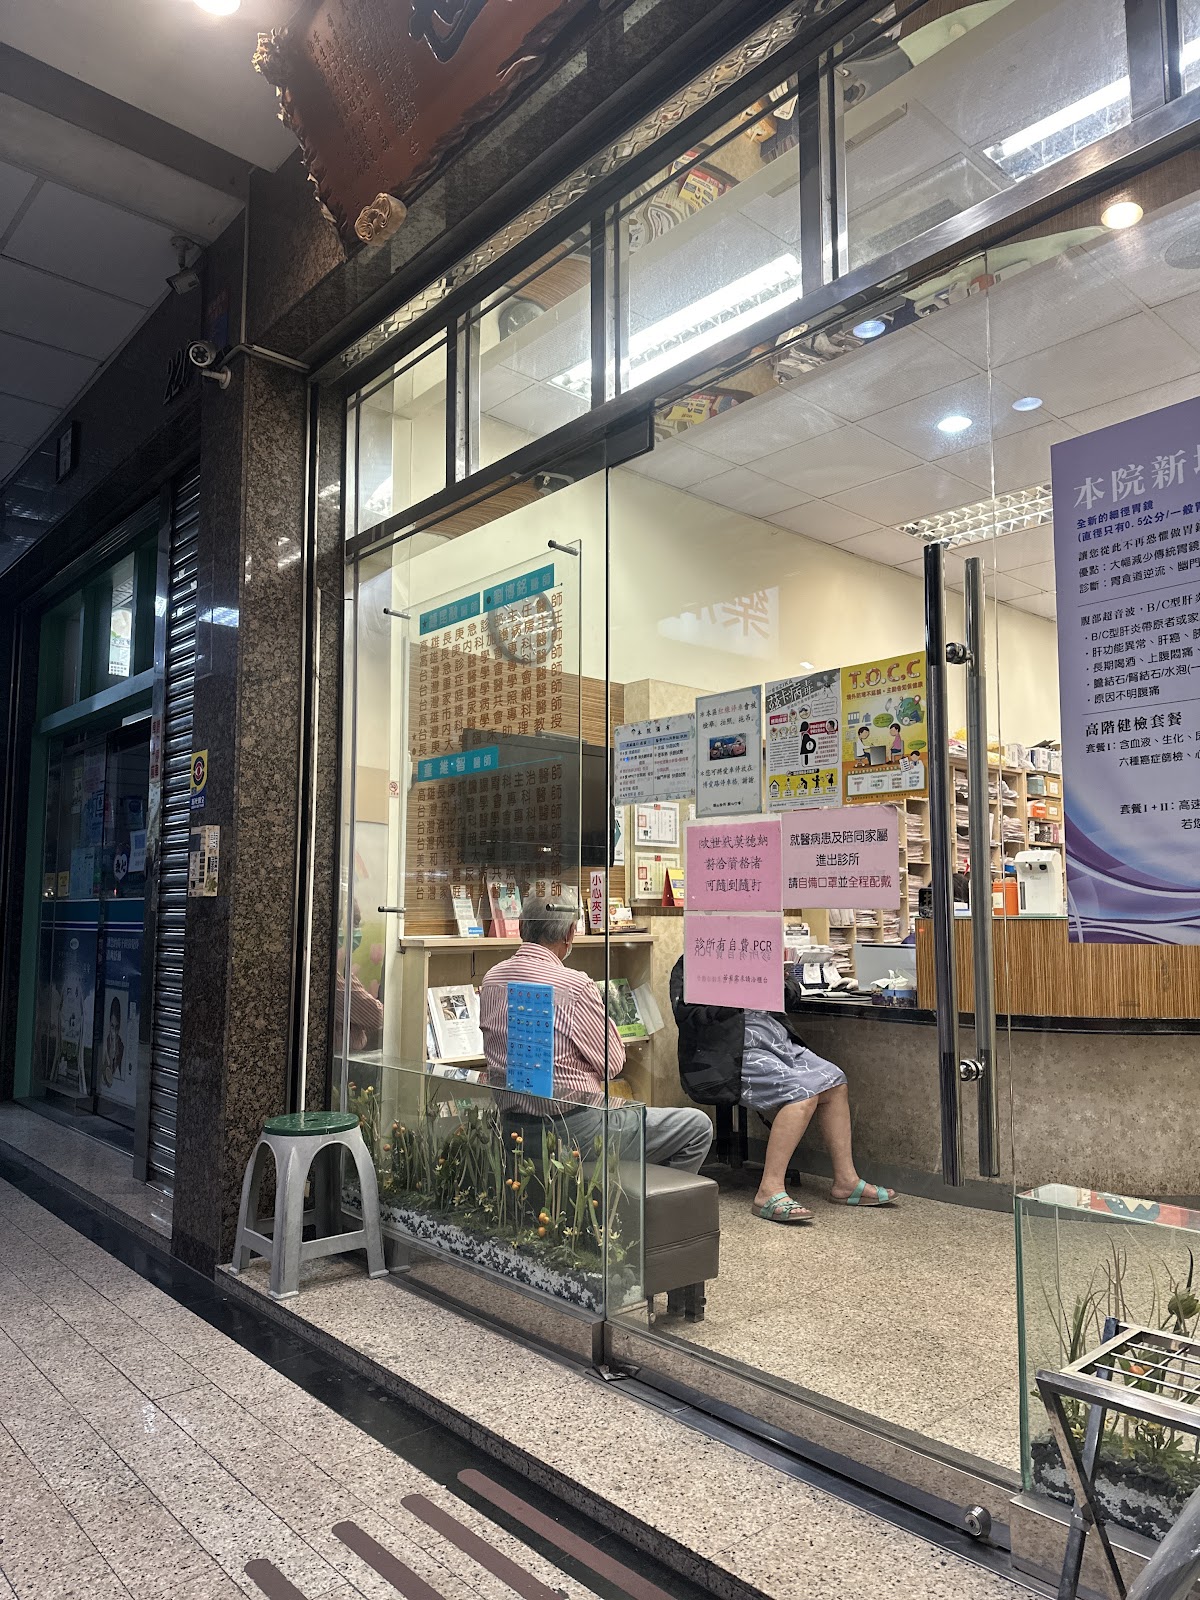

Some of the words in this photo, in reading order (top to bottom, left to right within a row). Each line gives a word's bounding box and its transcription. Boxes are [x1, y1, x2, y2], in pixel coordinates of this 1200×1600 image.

[1077, 500, 1154, 529] 全新的細徑胃鏡
[848, 659, 921, 689] T.O.C.C
[1094, 685, 1160, 704] 原因不明腹痛
[1086, 711, 1182, 737] 高階健檢套餐
[789, 828, 888, 847] 就醫病患及陪同家屬
[704, 856, 763, 870] 符合資格者
[815, 852, 860, 867] 進出診所
[705, 878, 762, 892] 可隨到隨打
[788, 875, 892, 889] 請自備口罩並全程配戴
[592, 875, 602, 925] 小心夾手
[694, 937, 749, 952] 診所有自費
[753, 940, 772, 952] PCR
